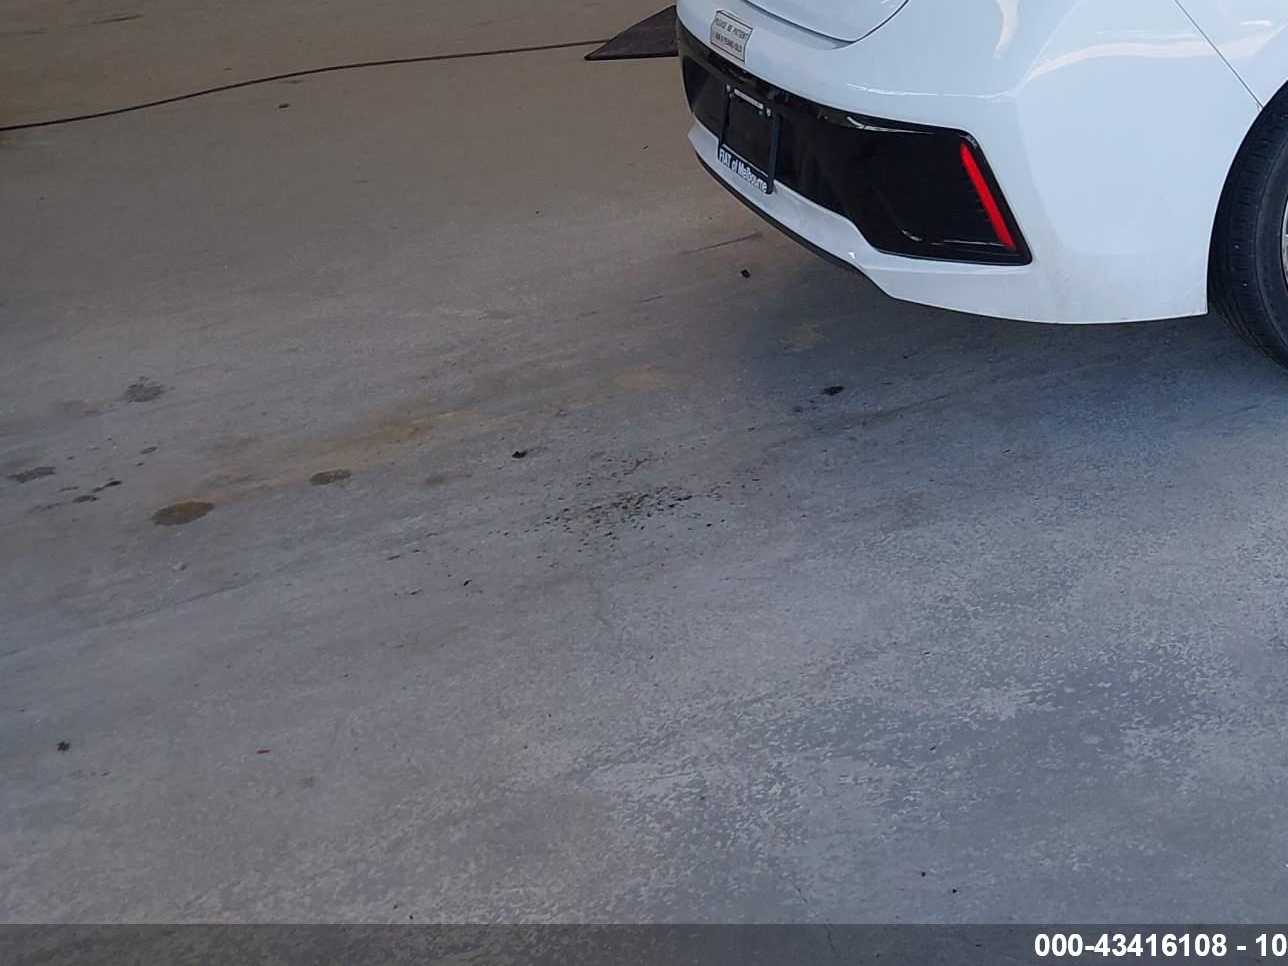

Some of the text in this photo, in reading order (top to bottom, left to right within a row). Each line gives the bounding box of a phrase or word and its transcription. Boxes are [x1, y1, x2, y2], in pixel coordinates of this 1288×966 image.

[719, 147, 767, 193] FIAT of Melbourne
